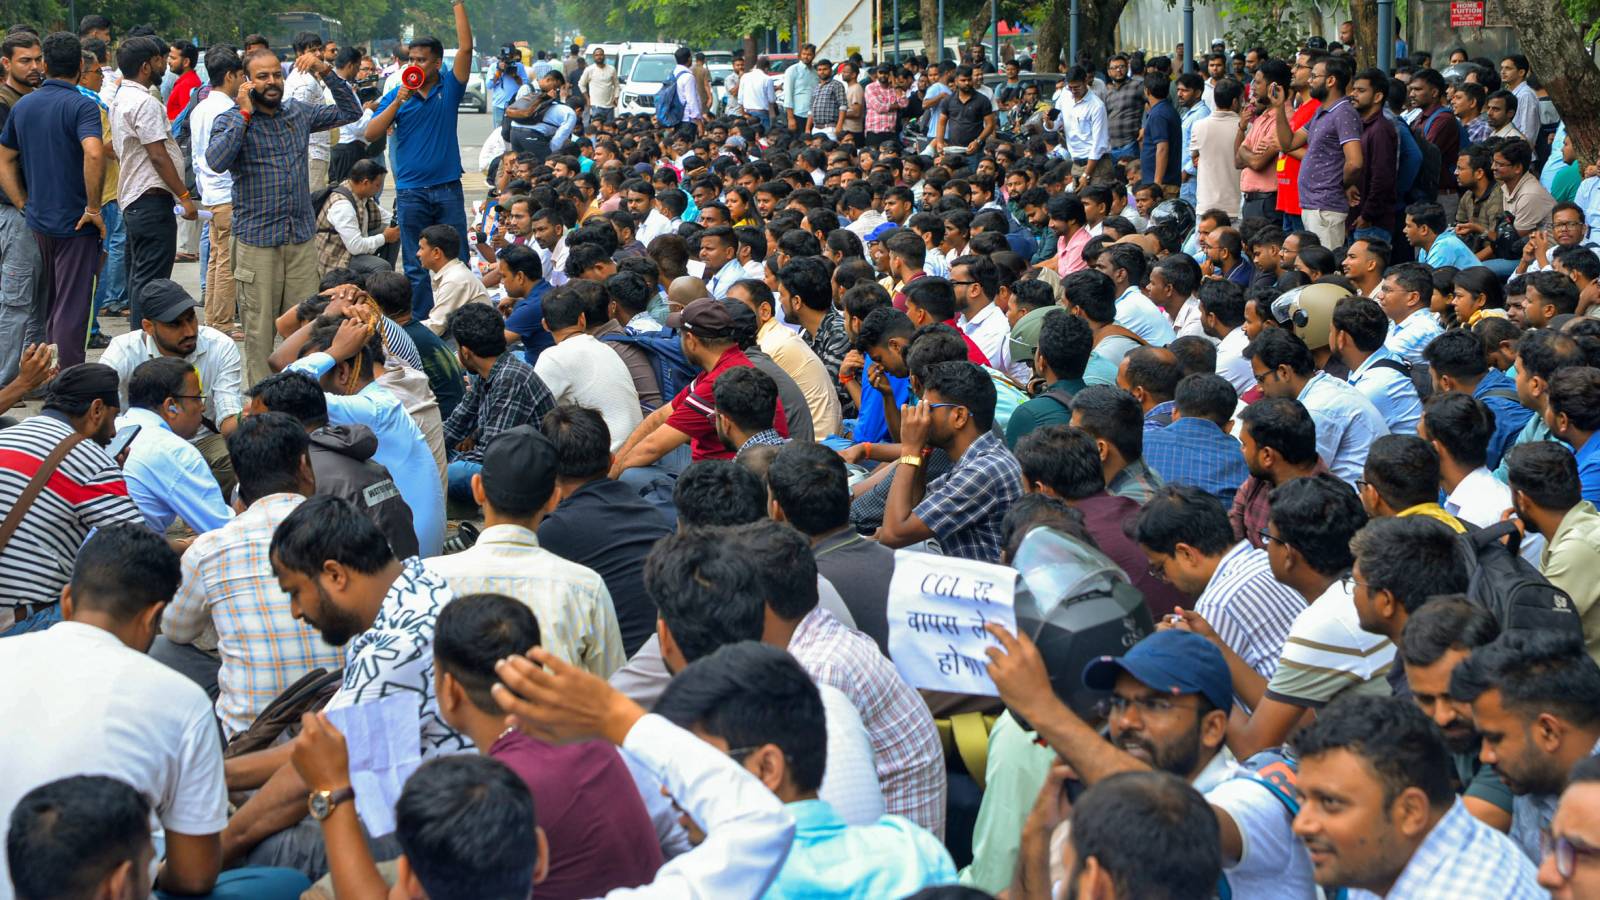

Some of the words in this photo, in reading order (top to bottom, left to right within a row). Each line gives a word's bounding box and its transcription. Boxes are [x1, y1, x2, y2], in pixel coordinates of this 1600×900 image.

[920, 573, 960, 599] CGL
[906, 611, 960, 636] वापस
[936, 645, 983, 677] होगा
